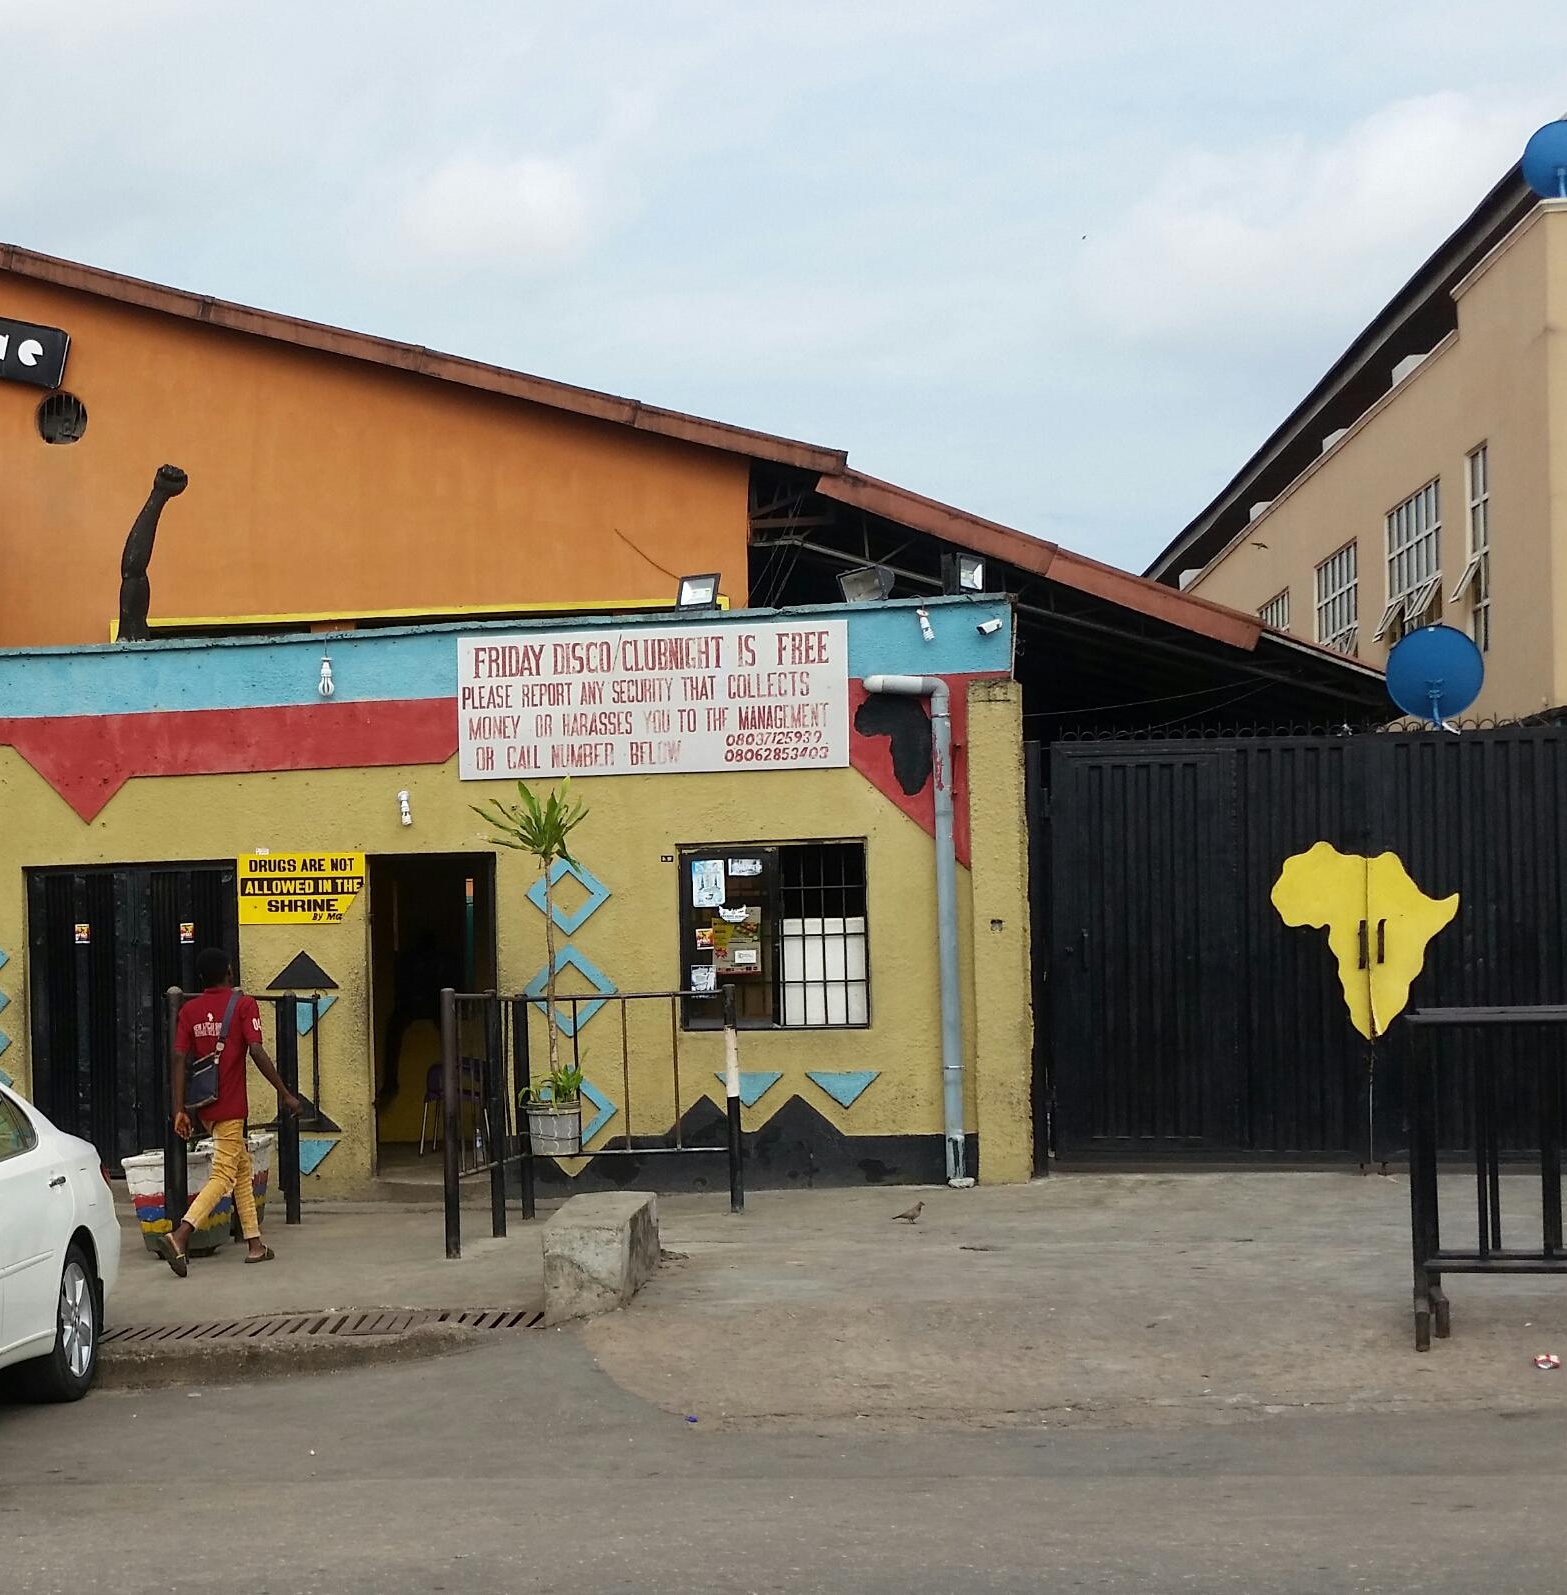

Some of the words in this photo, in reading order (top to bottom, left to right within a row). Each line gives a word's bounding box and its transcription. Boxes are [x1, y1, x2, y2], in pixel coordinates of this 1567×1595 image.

[473, 644, 545, 679] FRIDAY
[737, 634, 756, 667] IS
[776, 631, 830, 666] FREE
[462, 684, 513, 710] PLEASE
[522, 682, 572, 708] REPORT
[580, 681, 605, 705] ANY
[612, 677, 673, 704] SECURITY
[681, 675, 716, 701] THAT
[728, 671, 810, 699] COLLECTS
[469, 715, 521, 741] MONEY
[536, 714, 552, 738] OR
[562, 711, 633, 737] HARASSES
[643, 709, 671, 734] YOU
[677, 708, 697, 733] TO
[705, 706, 729, 732] THE
[738, 703, 829, 731] MANAGEMENT
[476, 746, 495, 771] OR
[507, 744, 541, 770] CALL
[551, 742, 615, 769] NUMBER
[630, 740, 682, 766] BELOW
[249, 859, 296, 872] DRUGS
[301, 858, 325, 872] ARE
[330, 858, 354, 871] NOT
[245, 880, 313, 894] ALLOWED
[318, 879, 332, 893] IN
[335, 879, 361, 893] THE
[267, 899, 338, 912] SHRINE
